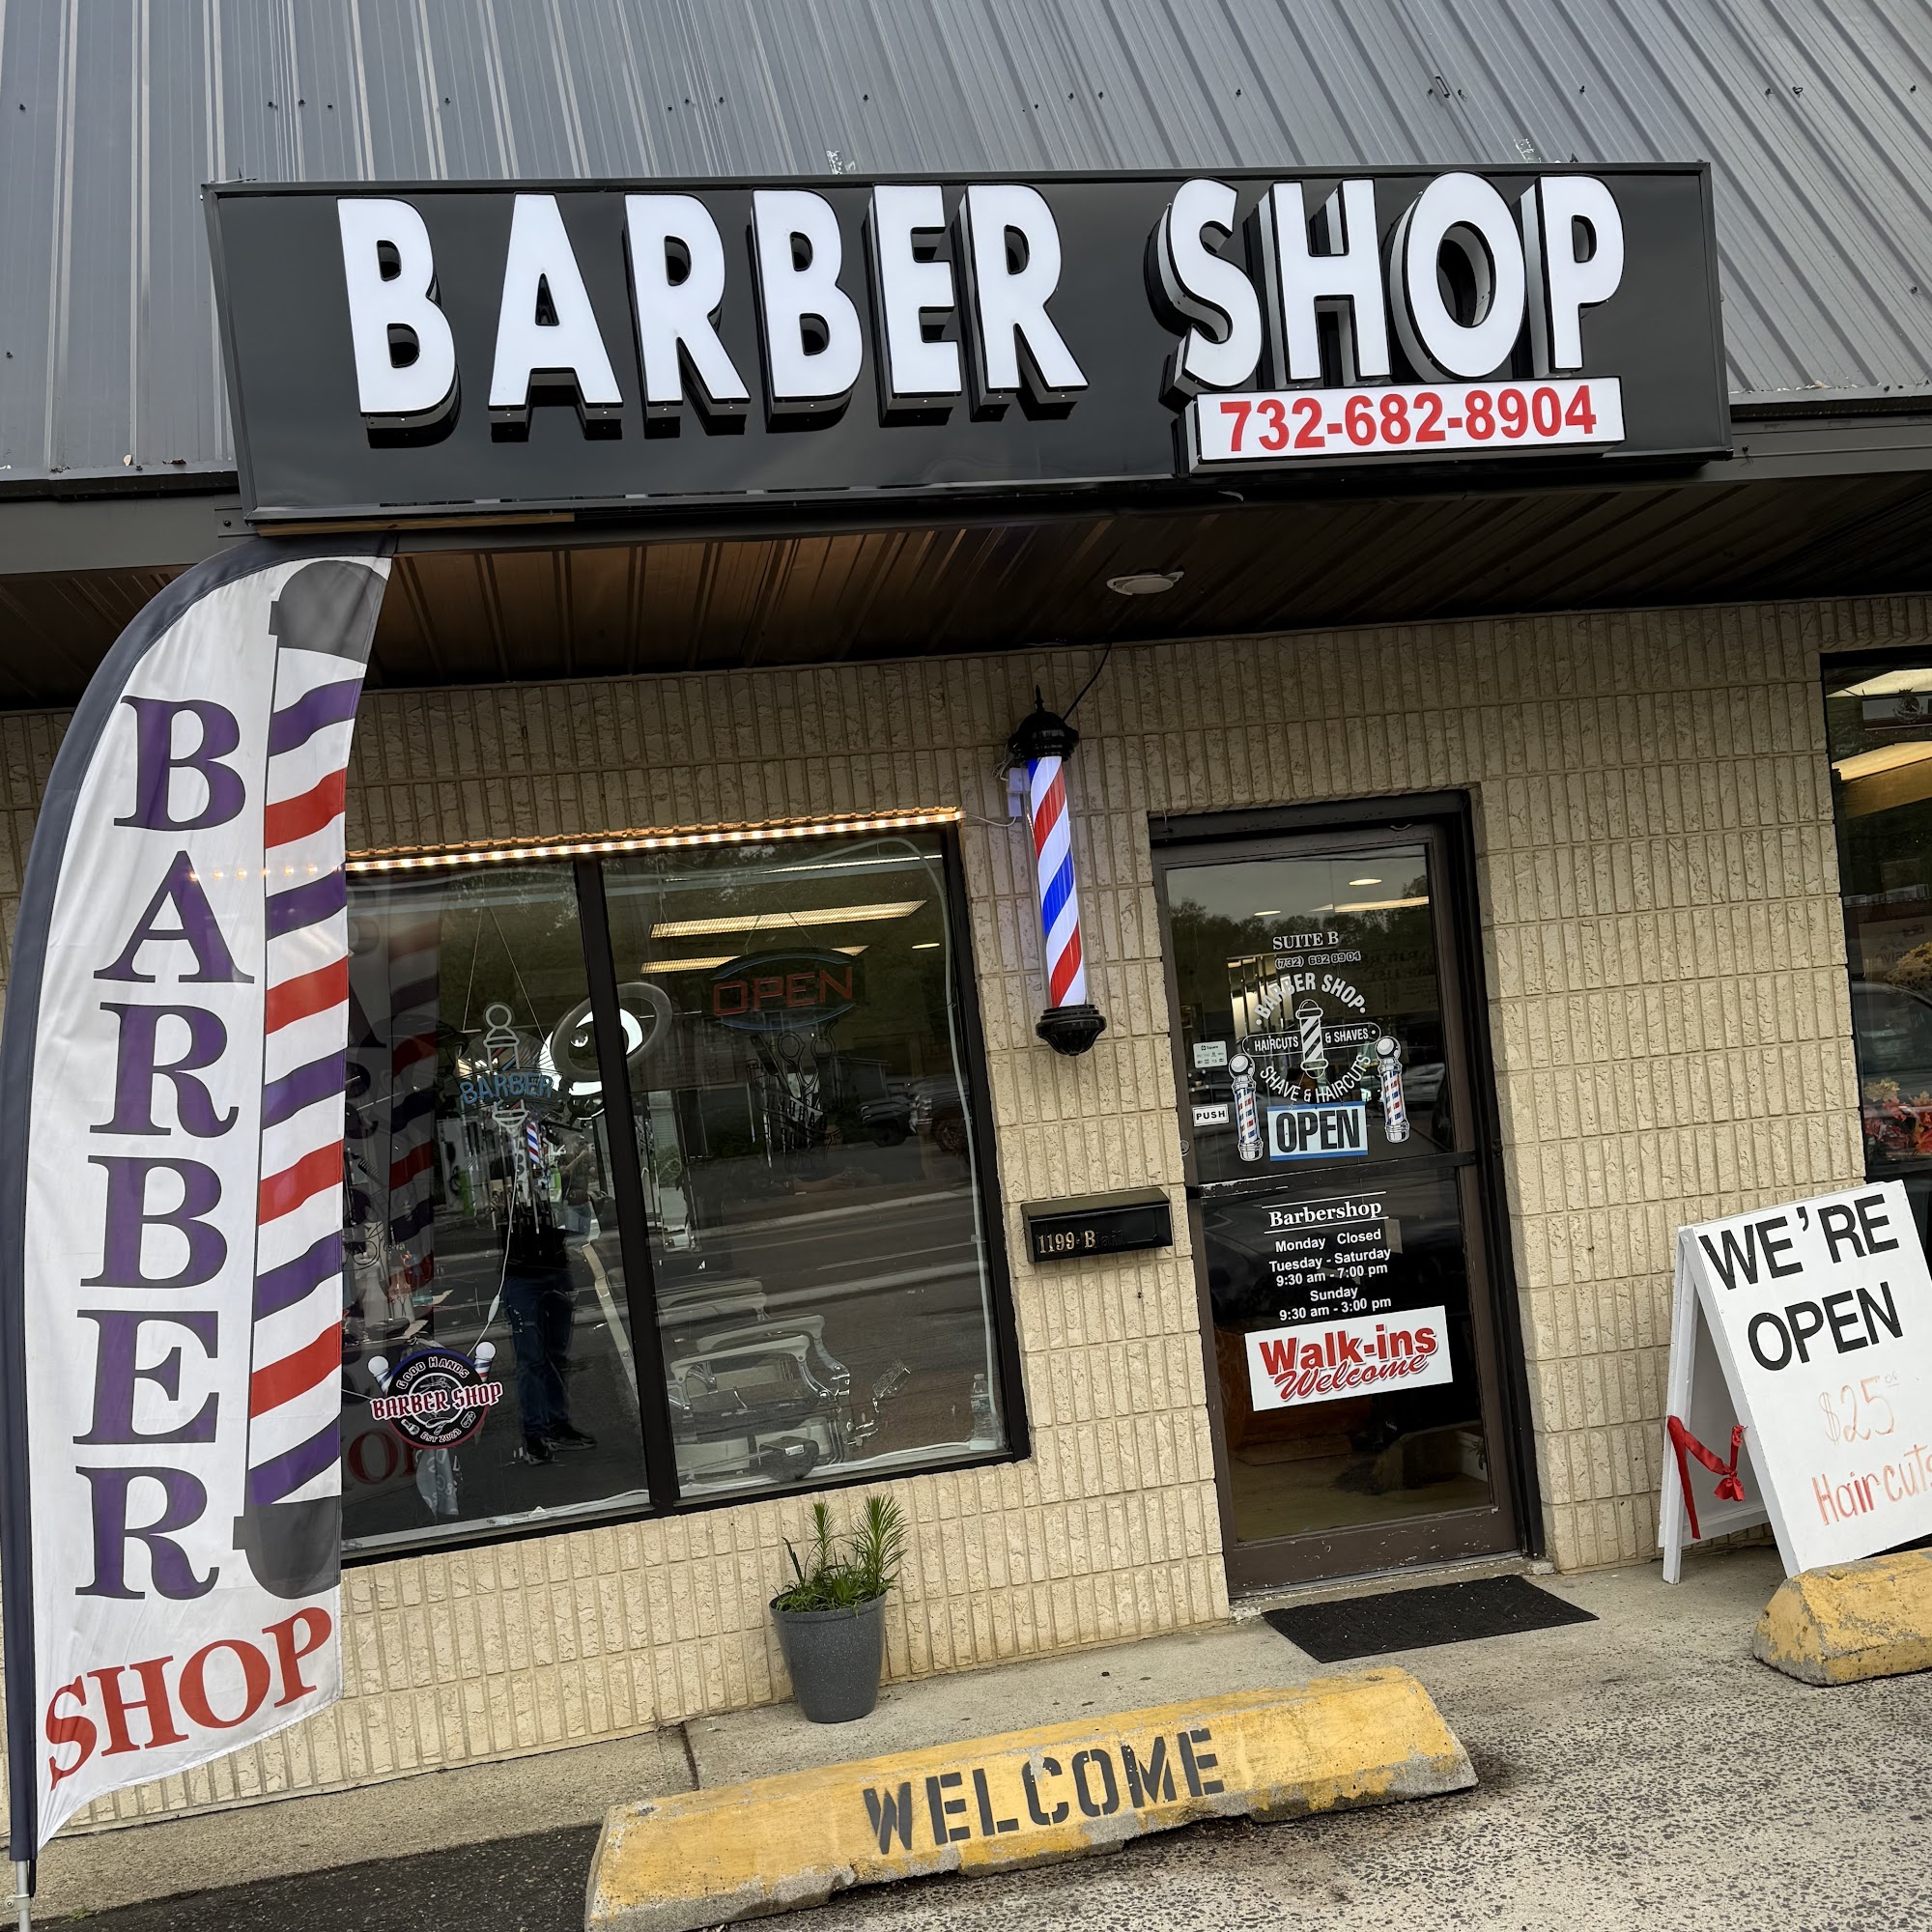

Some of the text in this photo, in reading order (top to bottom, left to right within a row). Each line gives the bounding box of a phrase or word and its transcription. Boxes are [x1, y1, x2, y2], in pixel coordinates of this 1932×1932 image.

[335, 171, 1625, 419] BARBER SHOP
[1219, 384, 1597, 452] 732-682-8904
[1272, 931, 1339, 950] SUITE B
[1275, 955, 1304, 970] (732)
[1308, 954, 1330, 966] 682
[713, 967, 853, 1016] OPEN
[1254, 972, 1366, 1020] BARBER SHOP
[1254, 1028, 1369, 1053] HAIRCUTS & SHAVES
[459, 1071, 554, 1105] BARBER
[1260, 1054, 1372, 1103] SHAVE & HAIRCUTS
[1196, 1109, 1226, 1121] PUSH
[1275, 1108, 1360, 1152] OPEN
[72, 695, 255, 1600] BARBER
[1268, 1200, 1382, 1228] Barbershop
[1038, 1231, 1075, 1254] 1199
[1275, 1228, 1381, 1253] Monday Closed
[1698, 1194, 1900, 1290] WE'RE
[1268, 1256, 1322, 1273] Tuesday
[1334, 1247, 1391, 1264] Saturday
[1276, 1273, 1303, 1287] 9:30
[1306, 1271, 1326, 1284] am
[1337, 1265, 1364, 1279] 7:00
[1368, 1264, 1388, 1278] pm
[1279, 1307, 1306, 1321] 9:30
[1310, 1305, 1330, 1318] am
[1341, 1299, 1367, 1314] 3:00
[1372, 1297, 1392, 1312] pm
[1310, 1287, 1358, 1303] Sunday
[1747, 1281, 1904, 1371] OPEN
[1259, 1323, 1437, 1377] Walk-ins
[396, 1356, 469, 1389] GOOD HANDS
[1273, 1353, 1429, 1401] Welcome
[370, 1382, 502, 1420] BARBER SHOP
[420, 1431, 438, 1442] EST
[44, 1607, 332, 1792] SHOP
[863, 1726, 1225, 1856] WELCOME
